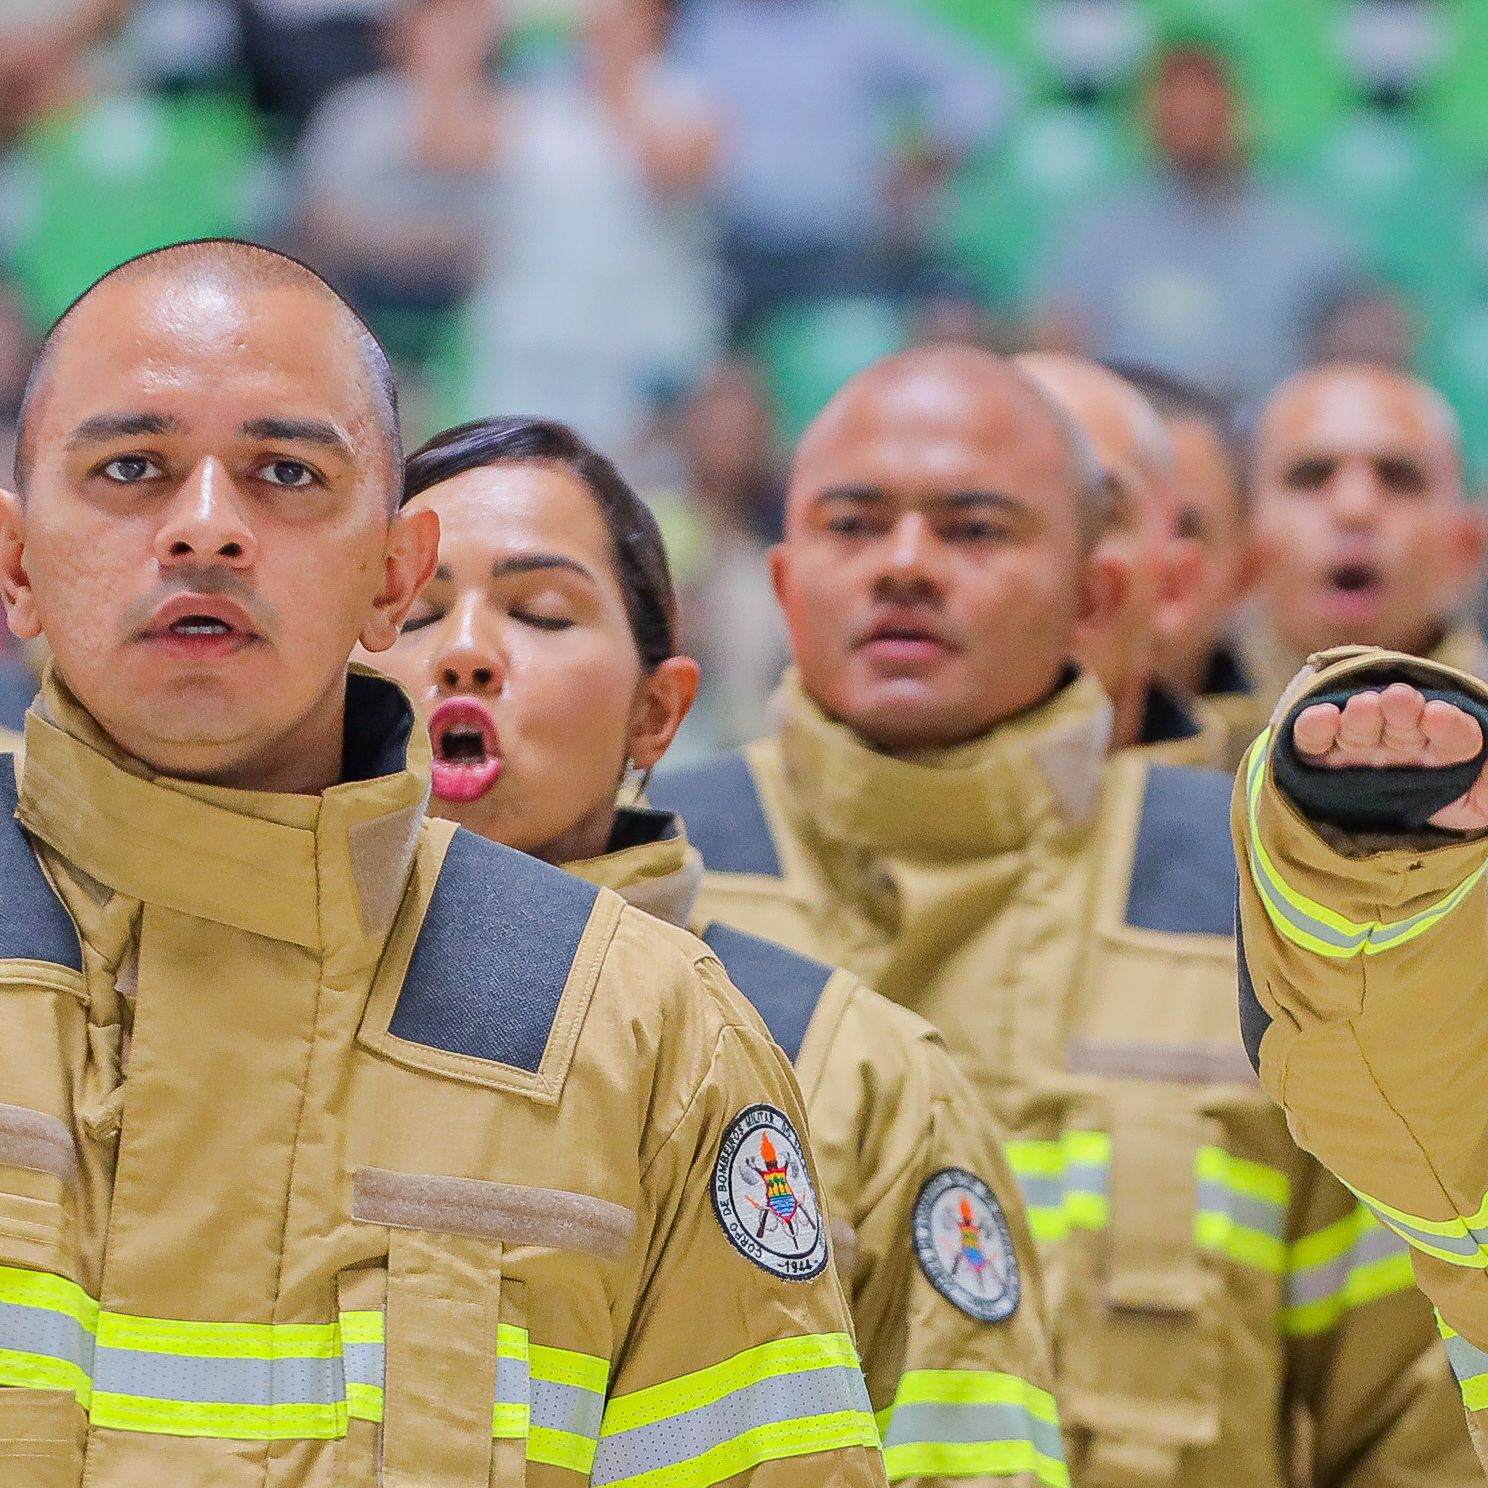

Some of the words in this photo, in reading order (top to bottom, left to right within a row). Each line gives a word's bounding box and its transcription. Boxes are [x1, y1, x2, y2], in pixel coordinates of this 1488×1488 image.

[717, 1123, 744, 1192] BOMBEIROS
[714, 1198, 732, 1217] DE
[729, 1222, 763, 1259] CORPO
